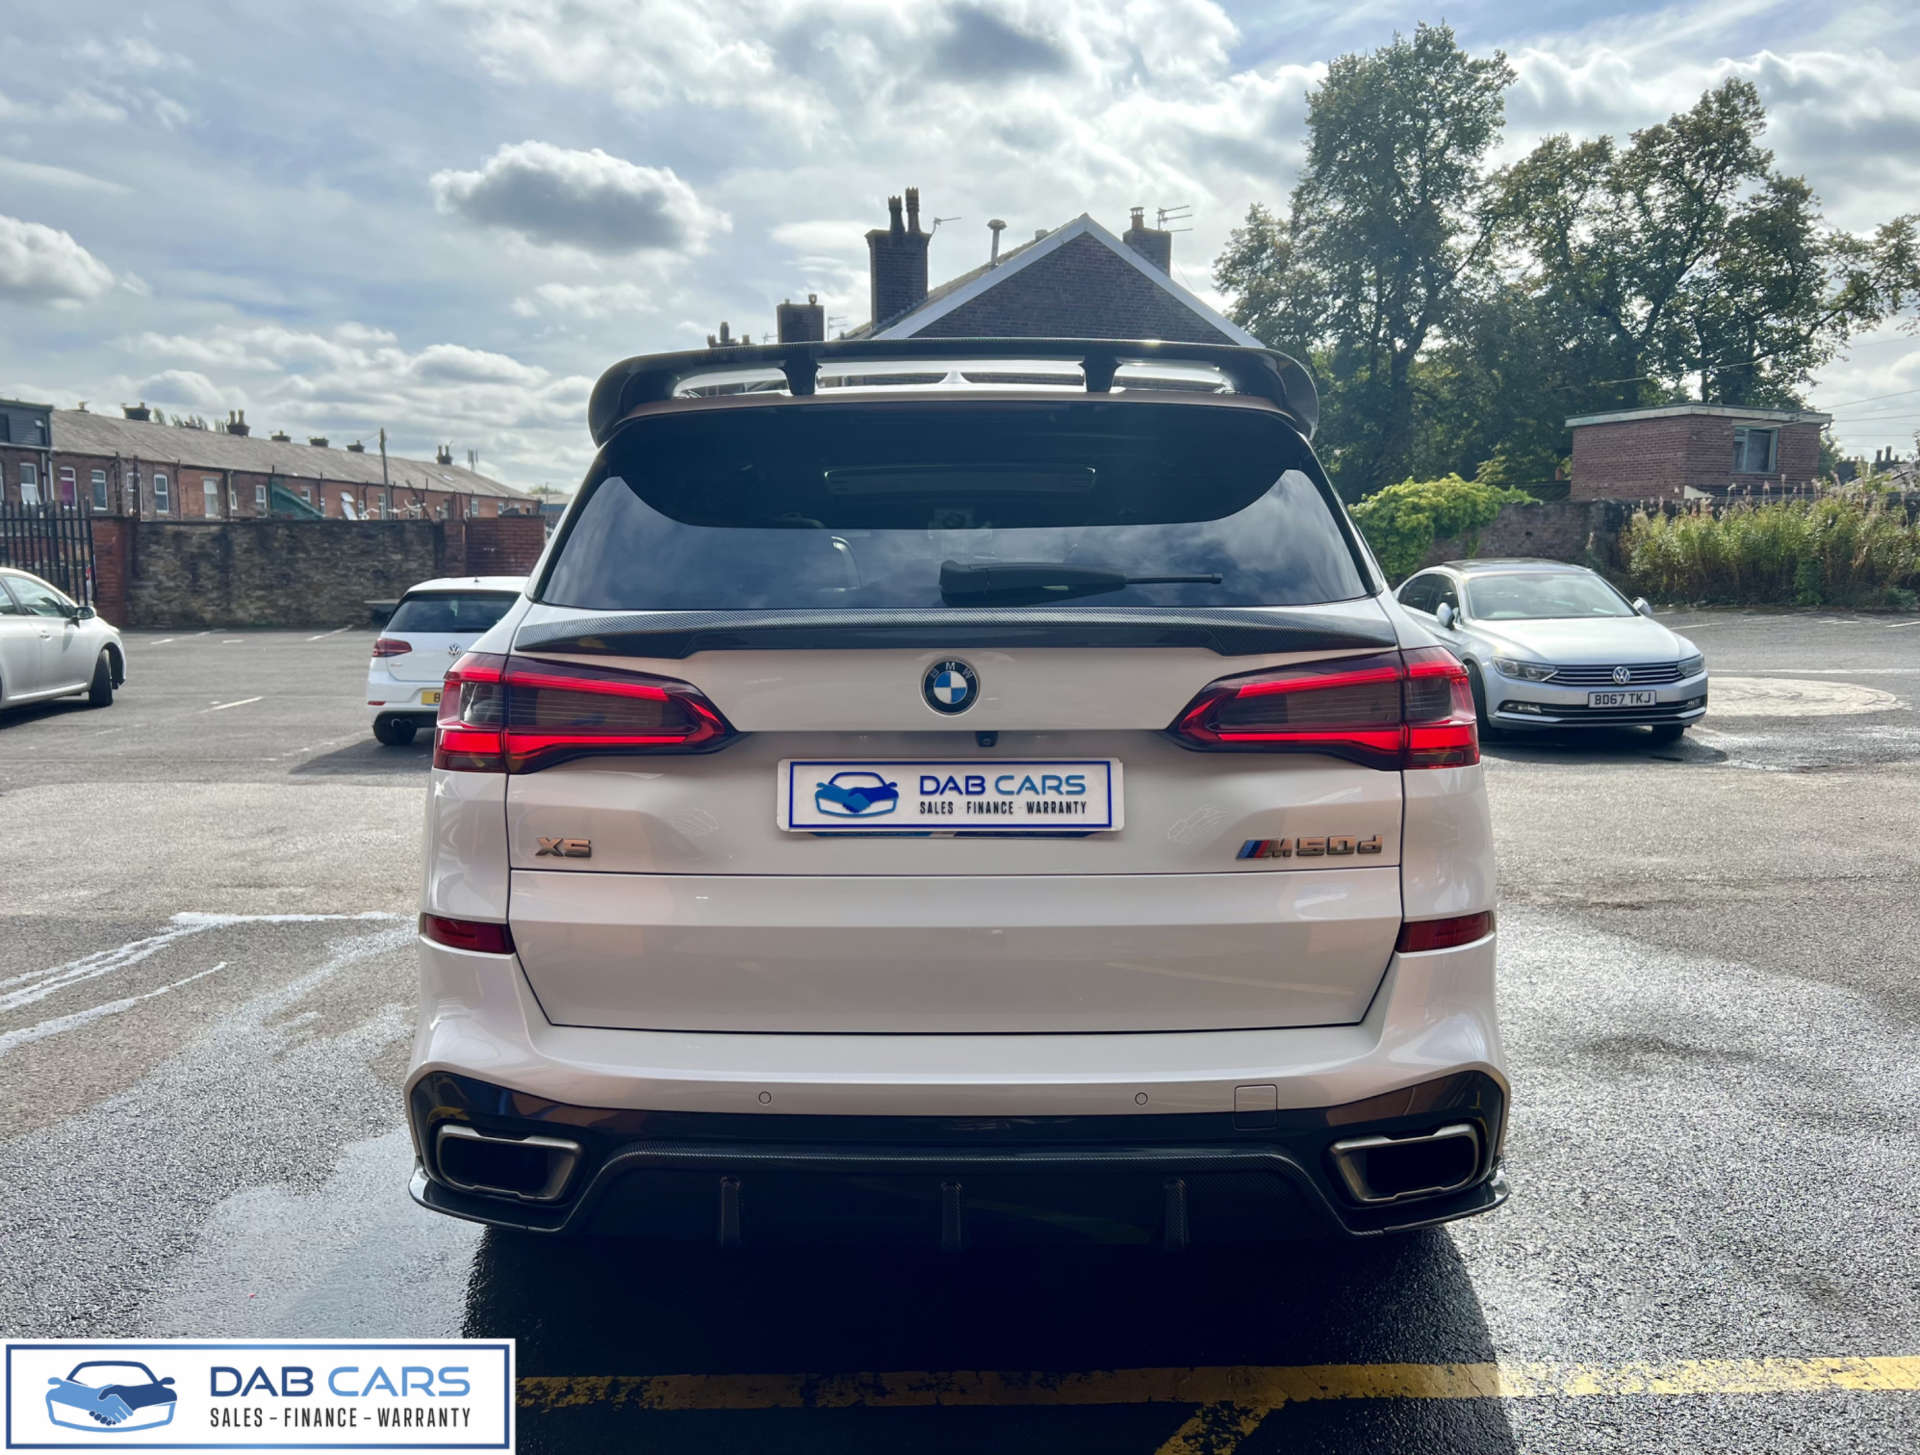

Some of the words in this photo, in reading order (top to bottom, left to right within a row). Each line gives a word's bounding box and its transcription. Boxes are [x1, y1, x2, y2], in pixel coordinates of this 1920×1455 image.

[930, 662, 976, 679] BMW
[1594, 694, 1625, 705] BD67
[1627, 692, 1652, 704] TKJ
[919, 775, 986, 796] DAB
[994, 774, 1086, 796] CARS
[919, 800, 954, 815] SALES
[966, 800, 1014, 815] FINANCE
[1026, 800, 1087, 815] WARRANTY
[535, 837, 592, 858] X5
